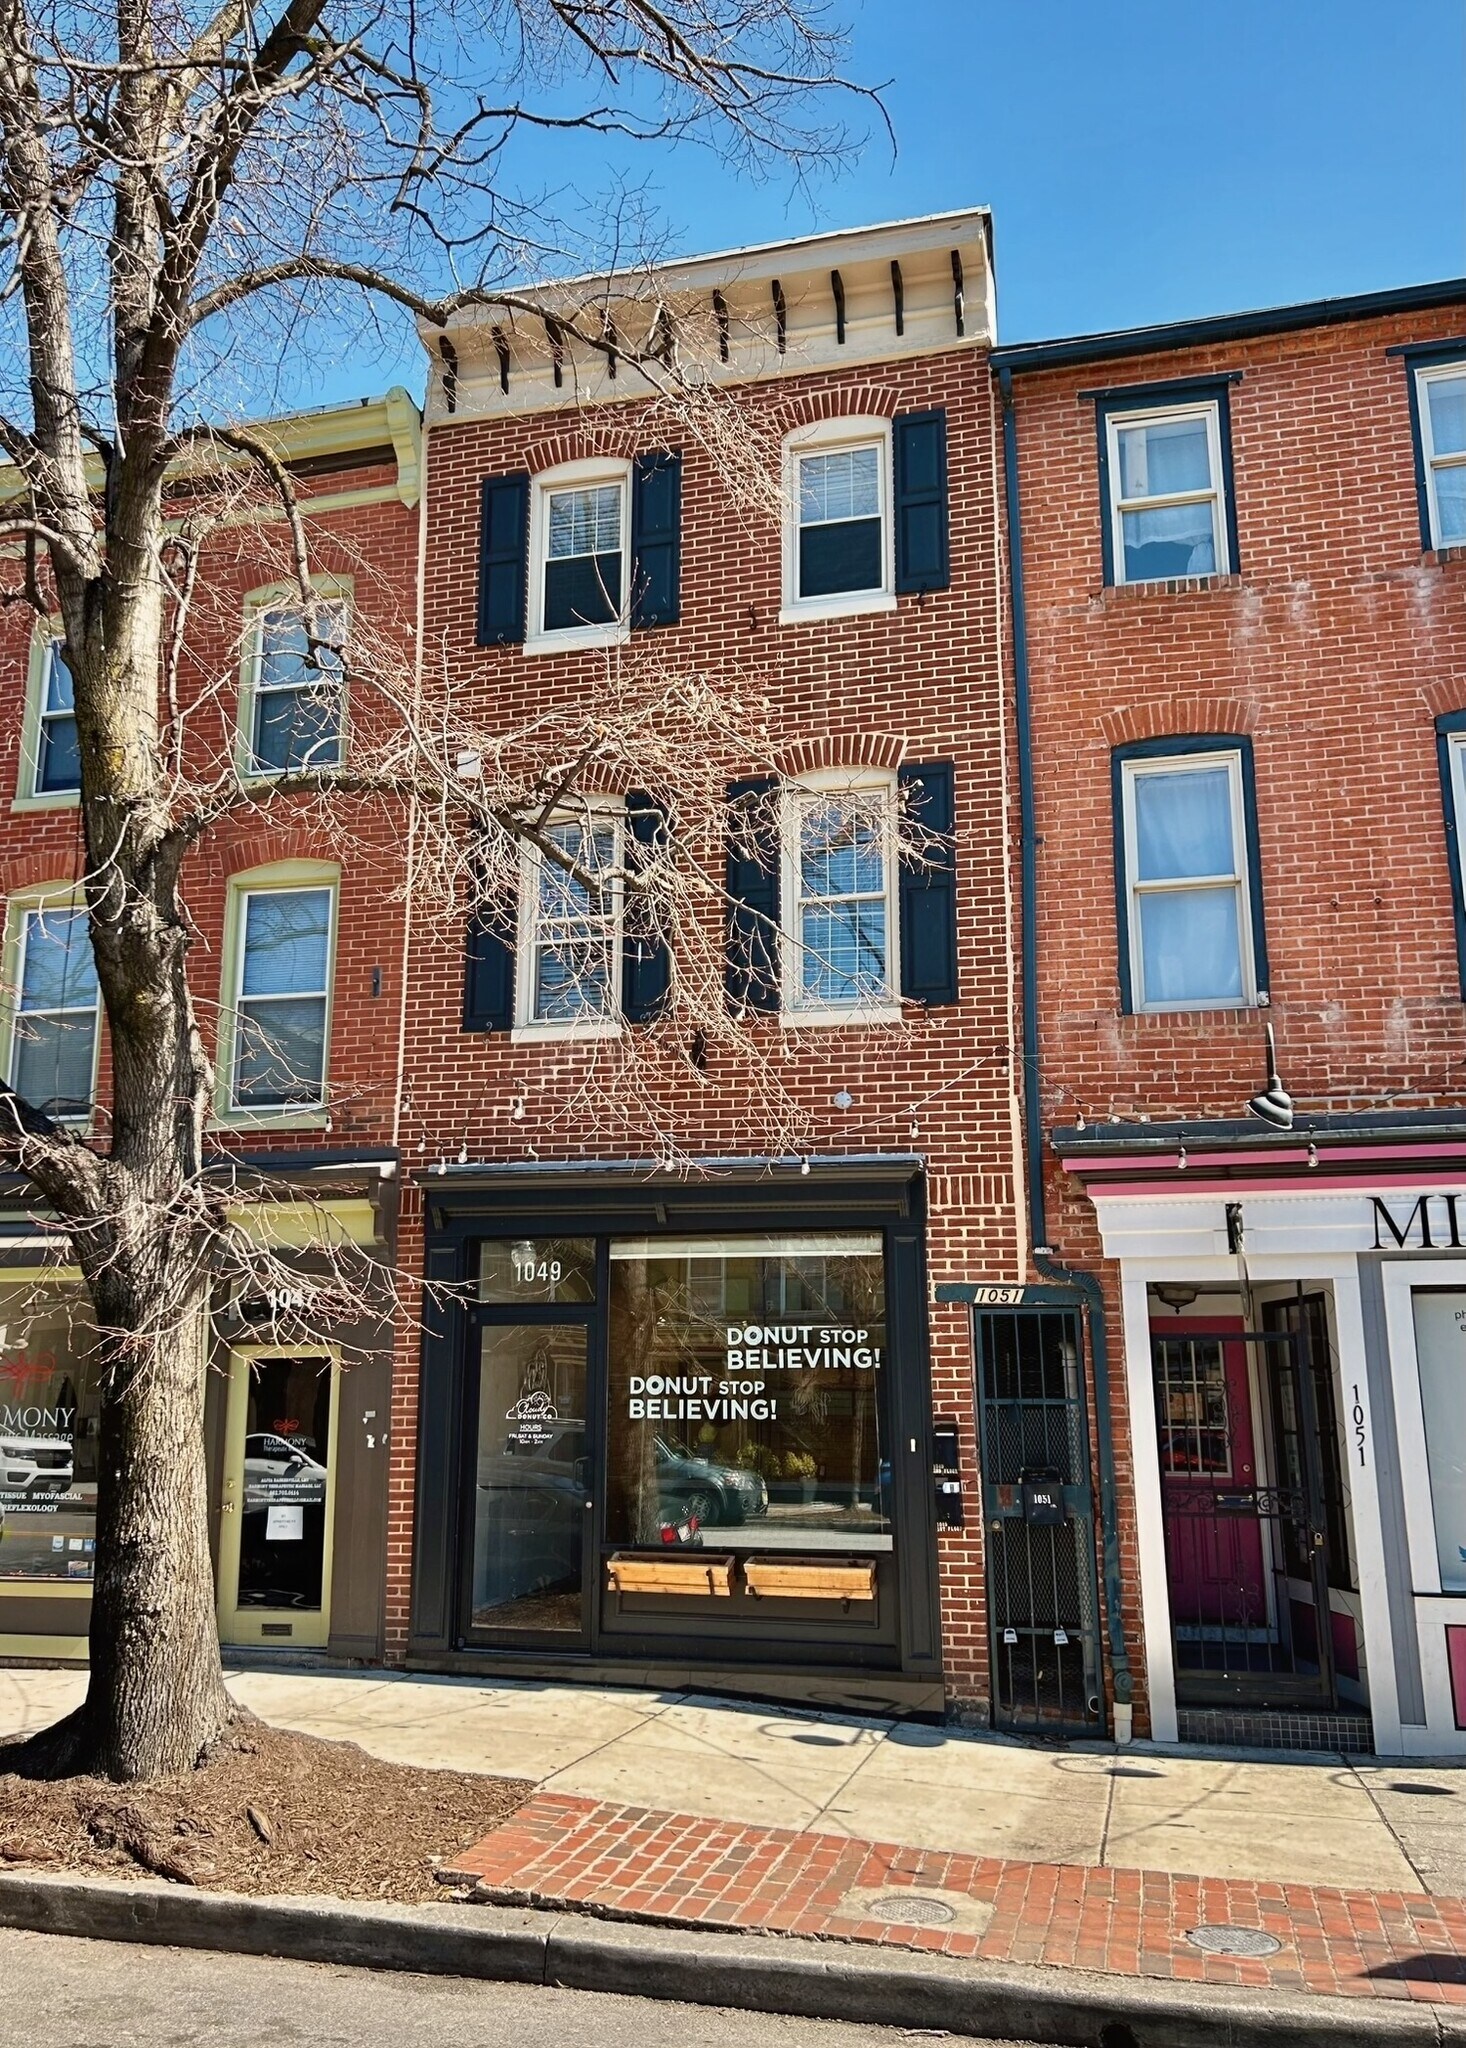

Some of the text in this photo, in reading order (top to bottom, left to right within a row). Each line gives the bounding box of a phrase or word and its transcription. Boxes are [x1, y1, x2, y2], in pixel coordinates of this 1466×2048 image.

[1366, 1194, 1466, 1249] MI
[515, 1261, 561, 1282] 1049
[979, 1289, 1020, 1303] 1051
[727, 1326, 868, 1346] DONUT STOP
[727, 1348, 880, 1370] BELIEVING!
[629, 1375, 766, 1395] DONUT STOP
[0, 1404, 75, 1432] MONY
[628, 1399, 777, 1420] BELIEVING!
[519, 1424, 542, 1432] HOURS
[1352, 1384, 1366, 1467] 1051
[263, 1438, 307, 1446] HARONY
[32, 1491, 83, 1500] MYOFASCIAL
